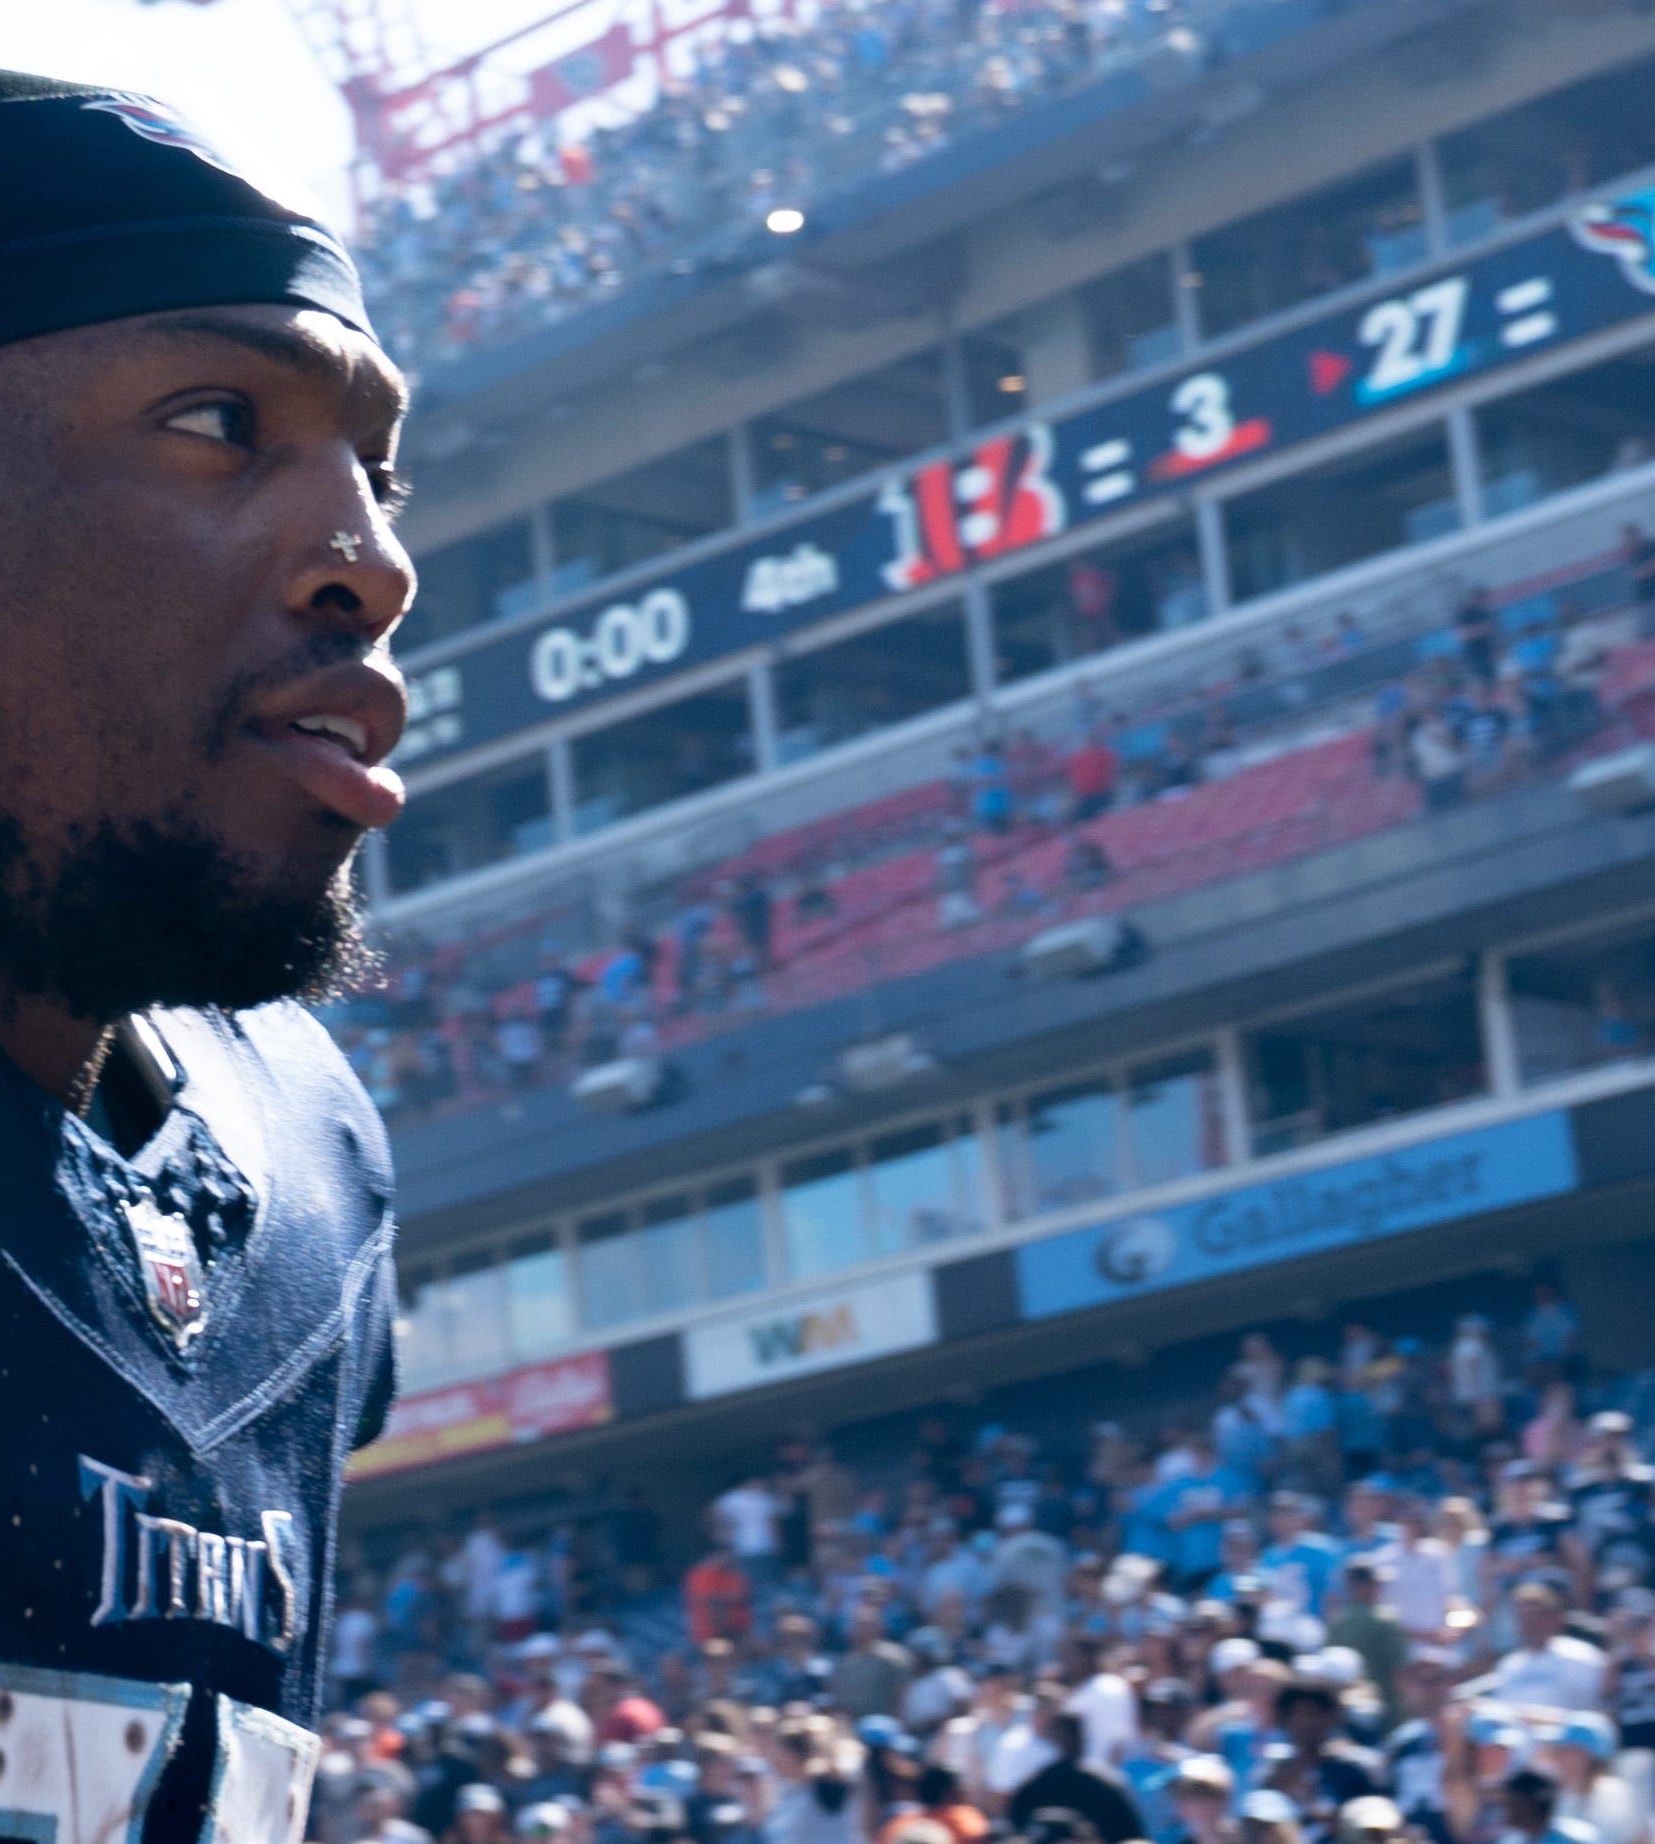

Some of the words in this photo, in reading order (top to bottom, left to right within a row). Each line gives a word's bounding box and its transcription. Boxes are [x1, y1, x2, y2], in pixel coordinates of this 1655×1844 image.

[531, 587, 690, 702] 0:00
[740, 542, 839, 613] 4th
[1172, 373, 1235, 458] 3
[1358, 276, 1468, 392] 27
[1193, 1152, 1484, 1256] Gallagher
[747, 1301, 860, 1368] WM
[78, 1452, 297, 1655] TITANS
